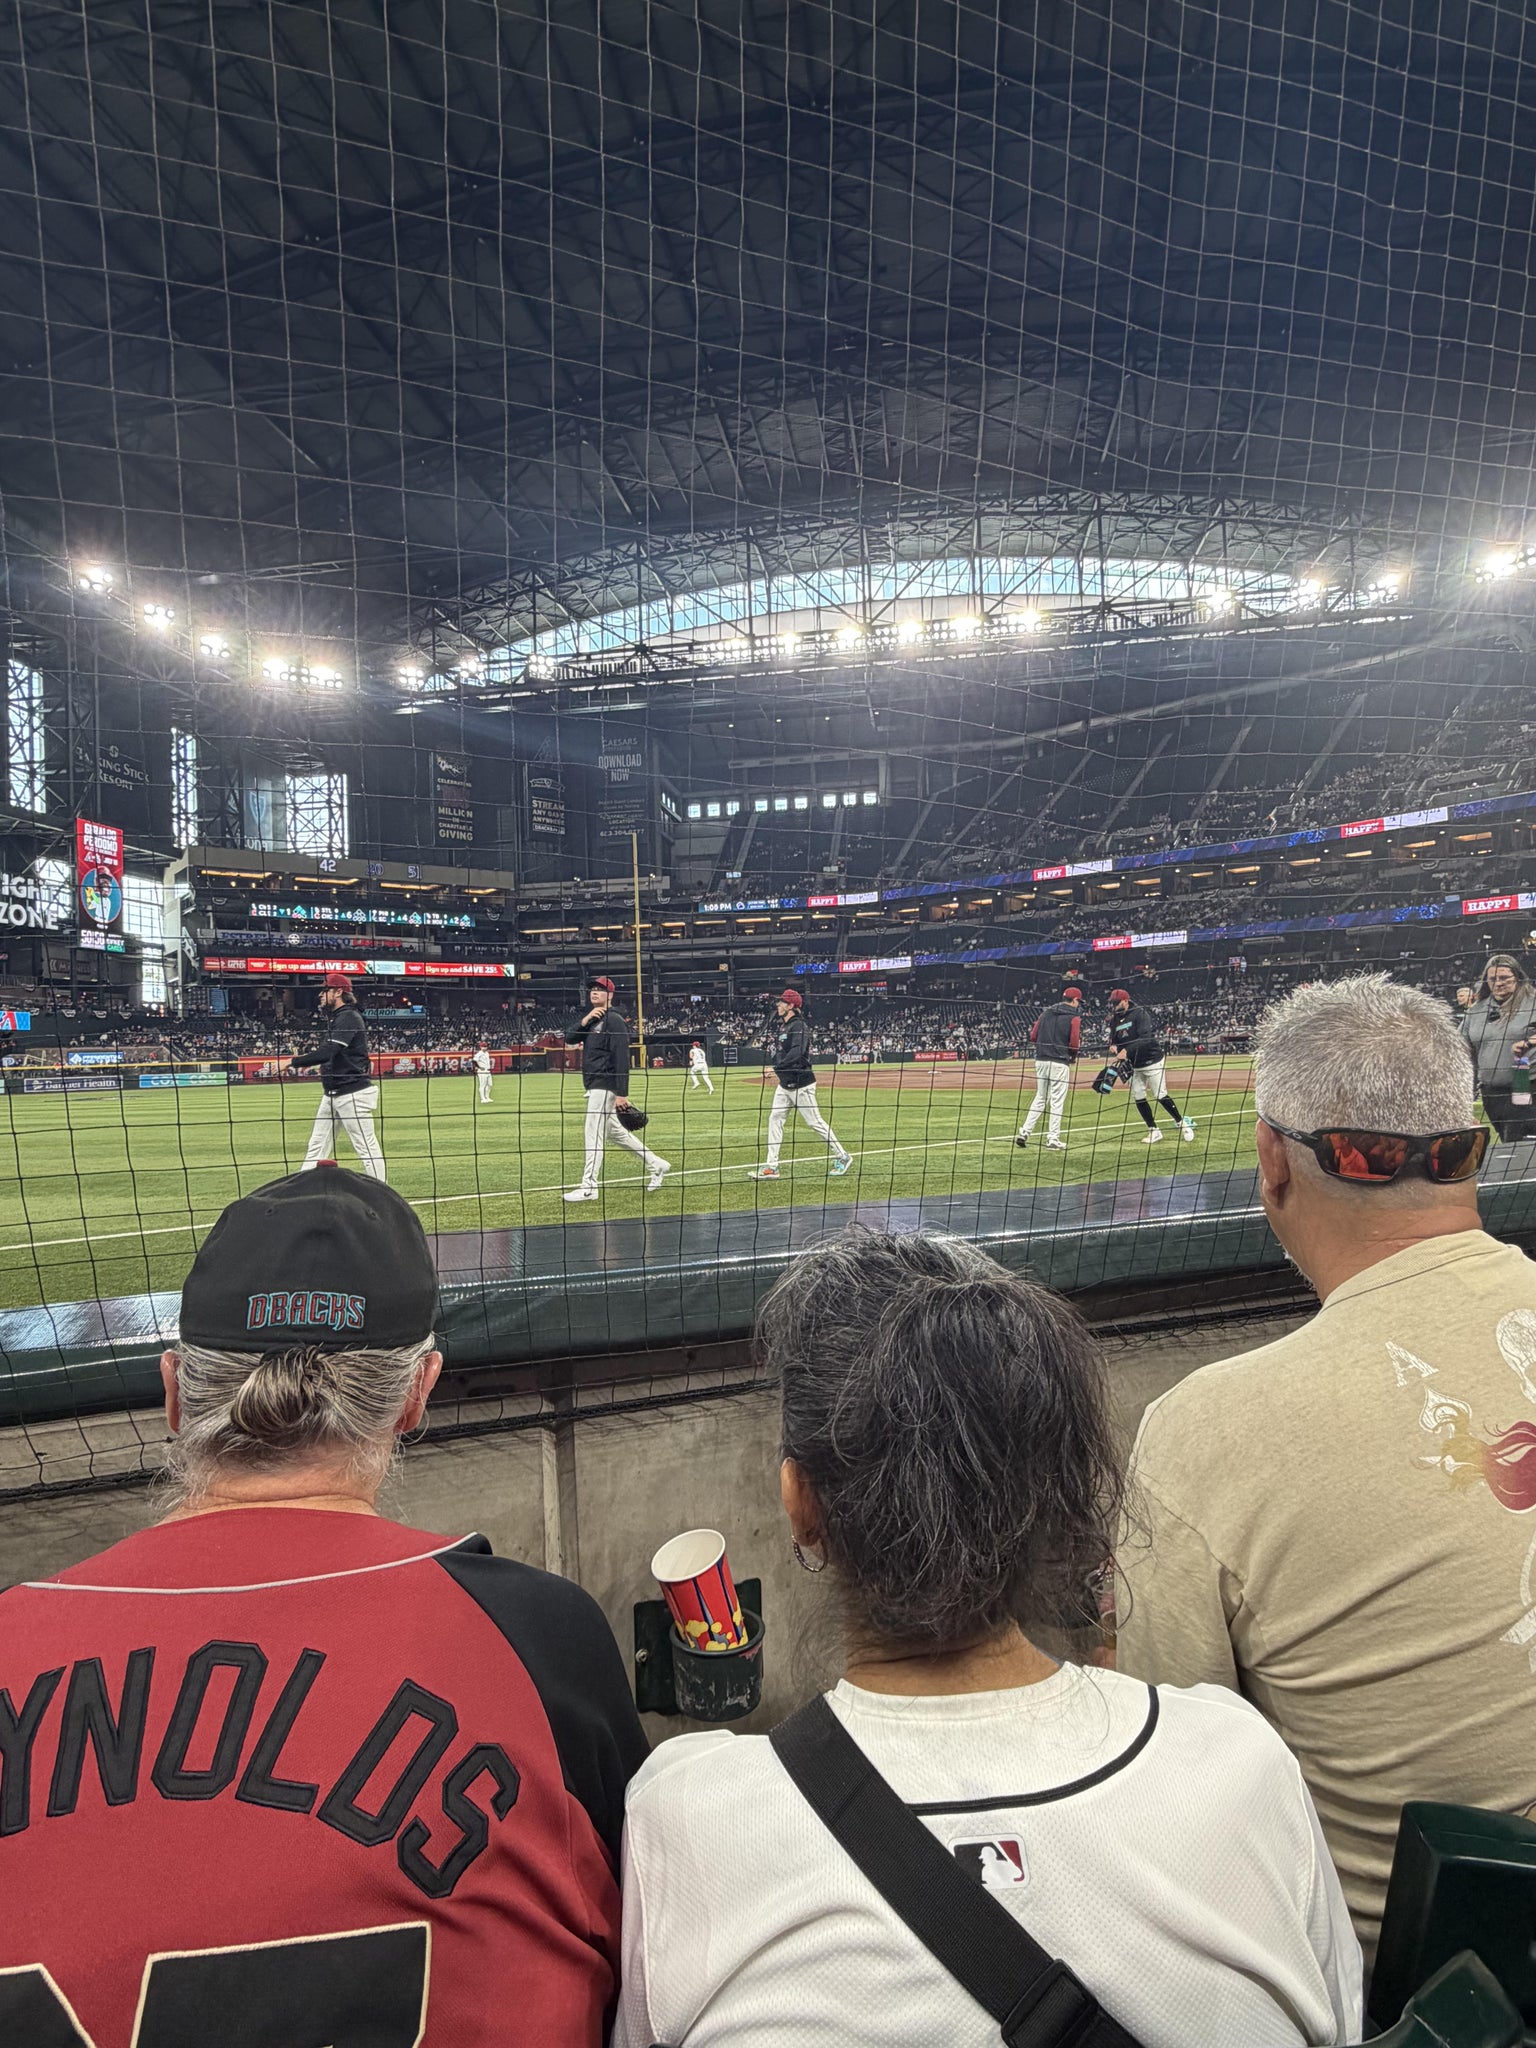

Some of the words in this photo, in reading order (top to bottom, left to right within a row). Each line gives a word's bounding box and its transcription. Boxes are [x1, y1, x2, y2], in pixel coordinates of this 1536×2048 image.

[599, 754, 642, 770] DOWNLOAD
[611, 768, 630, 782] NOW
[532, 799, 565, 810] STREAM
[438, 829, 474, 841] GIVING
[320, 860, 336, 872] 42
[1037, 869, 1062, 879] HAPPY
[720, 903, 732, 911] PM
[811, 898, 834, 906] HAPPY
[1467, 898, 1512, 912] HAPPY
[0, 902, 59, 930] ZONE
[268, 961, 287, 971] Sign
[288, 963, 299, 971] up
[300, 961, 315, 970] and
[316, 961, 341, 970] SAVE
[425, 965, 439, 974] Sign
[463, 966, 484, 974] SAVE
[843, 962, 867, 971] HAPPY
[83, 1078, 116, 1088] Health
[150, 1076, 179, 1086] COX
[188, 1074, 217, 1084] COX
[246, 1291, 366, 1331] DBACKS
